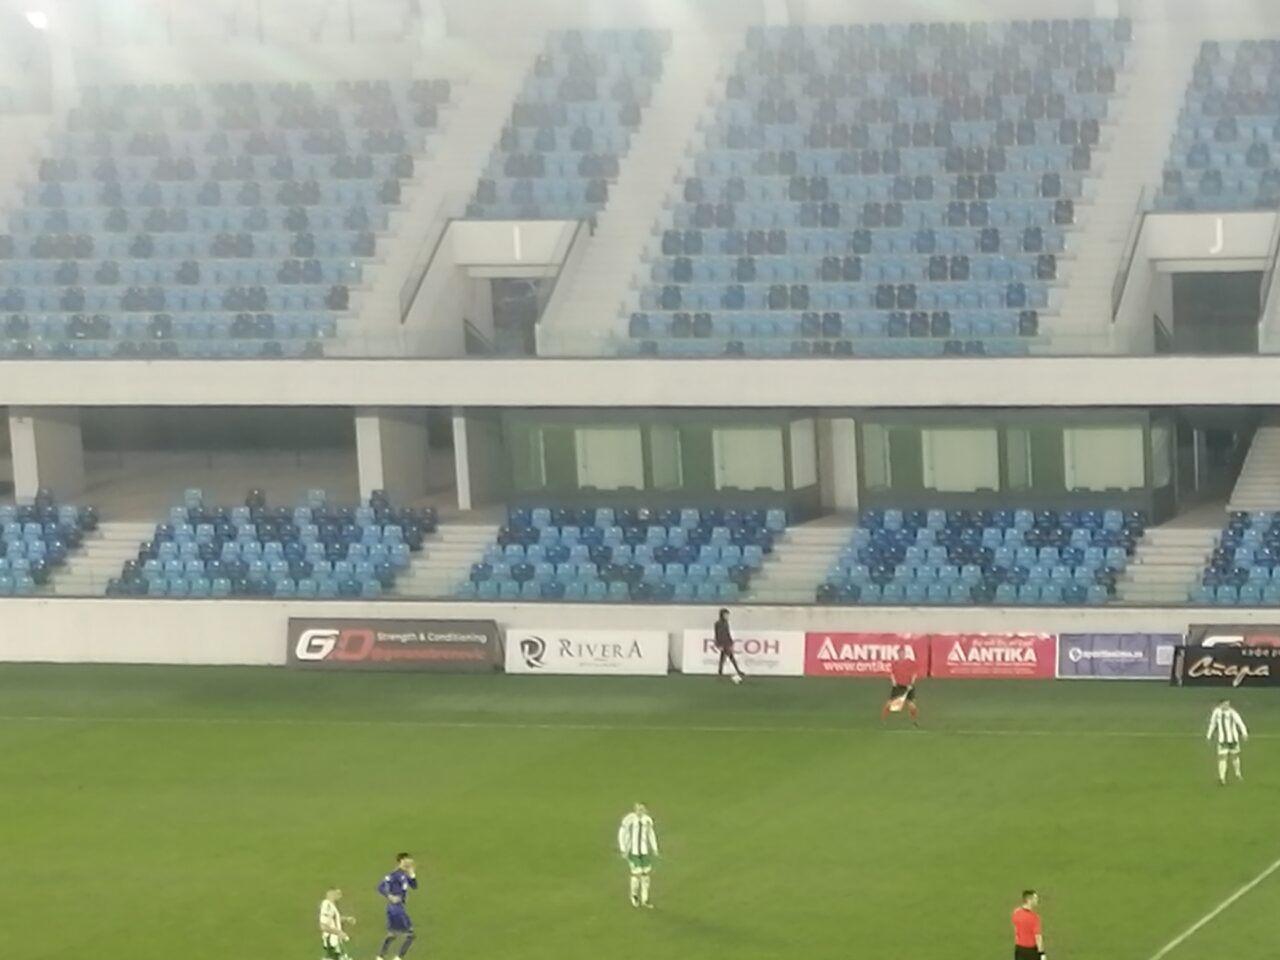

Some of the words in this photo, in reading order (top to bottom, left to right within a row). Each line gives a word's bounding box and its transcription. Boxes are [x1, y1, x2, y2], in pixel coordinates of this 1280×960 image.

[1209, 217, 1223, 254] J
[427, 632, 487, 644] Conditioning
[703, 639, 779, 655] RCOH
[840, 643, 915, 661] ANTIKA
[967, 646, 1037, 662] ANTIKA
